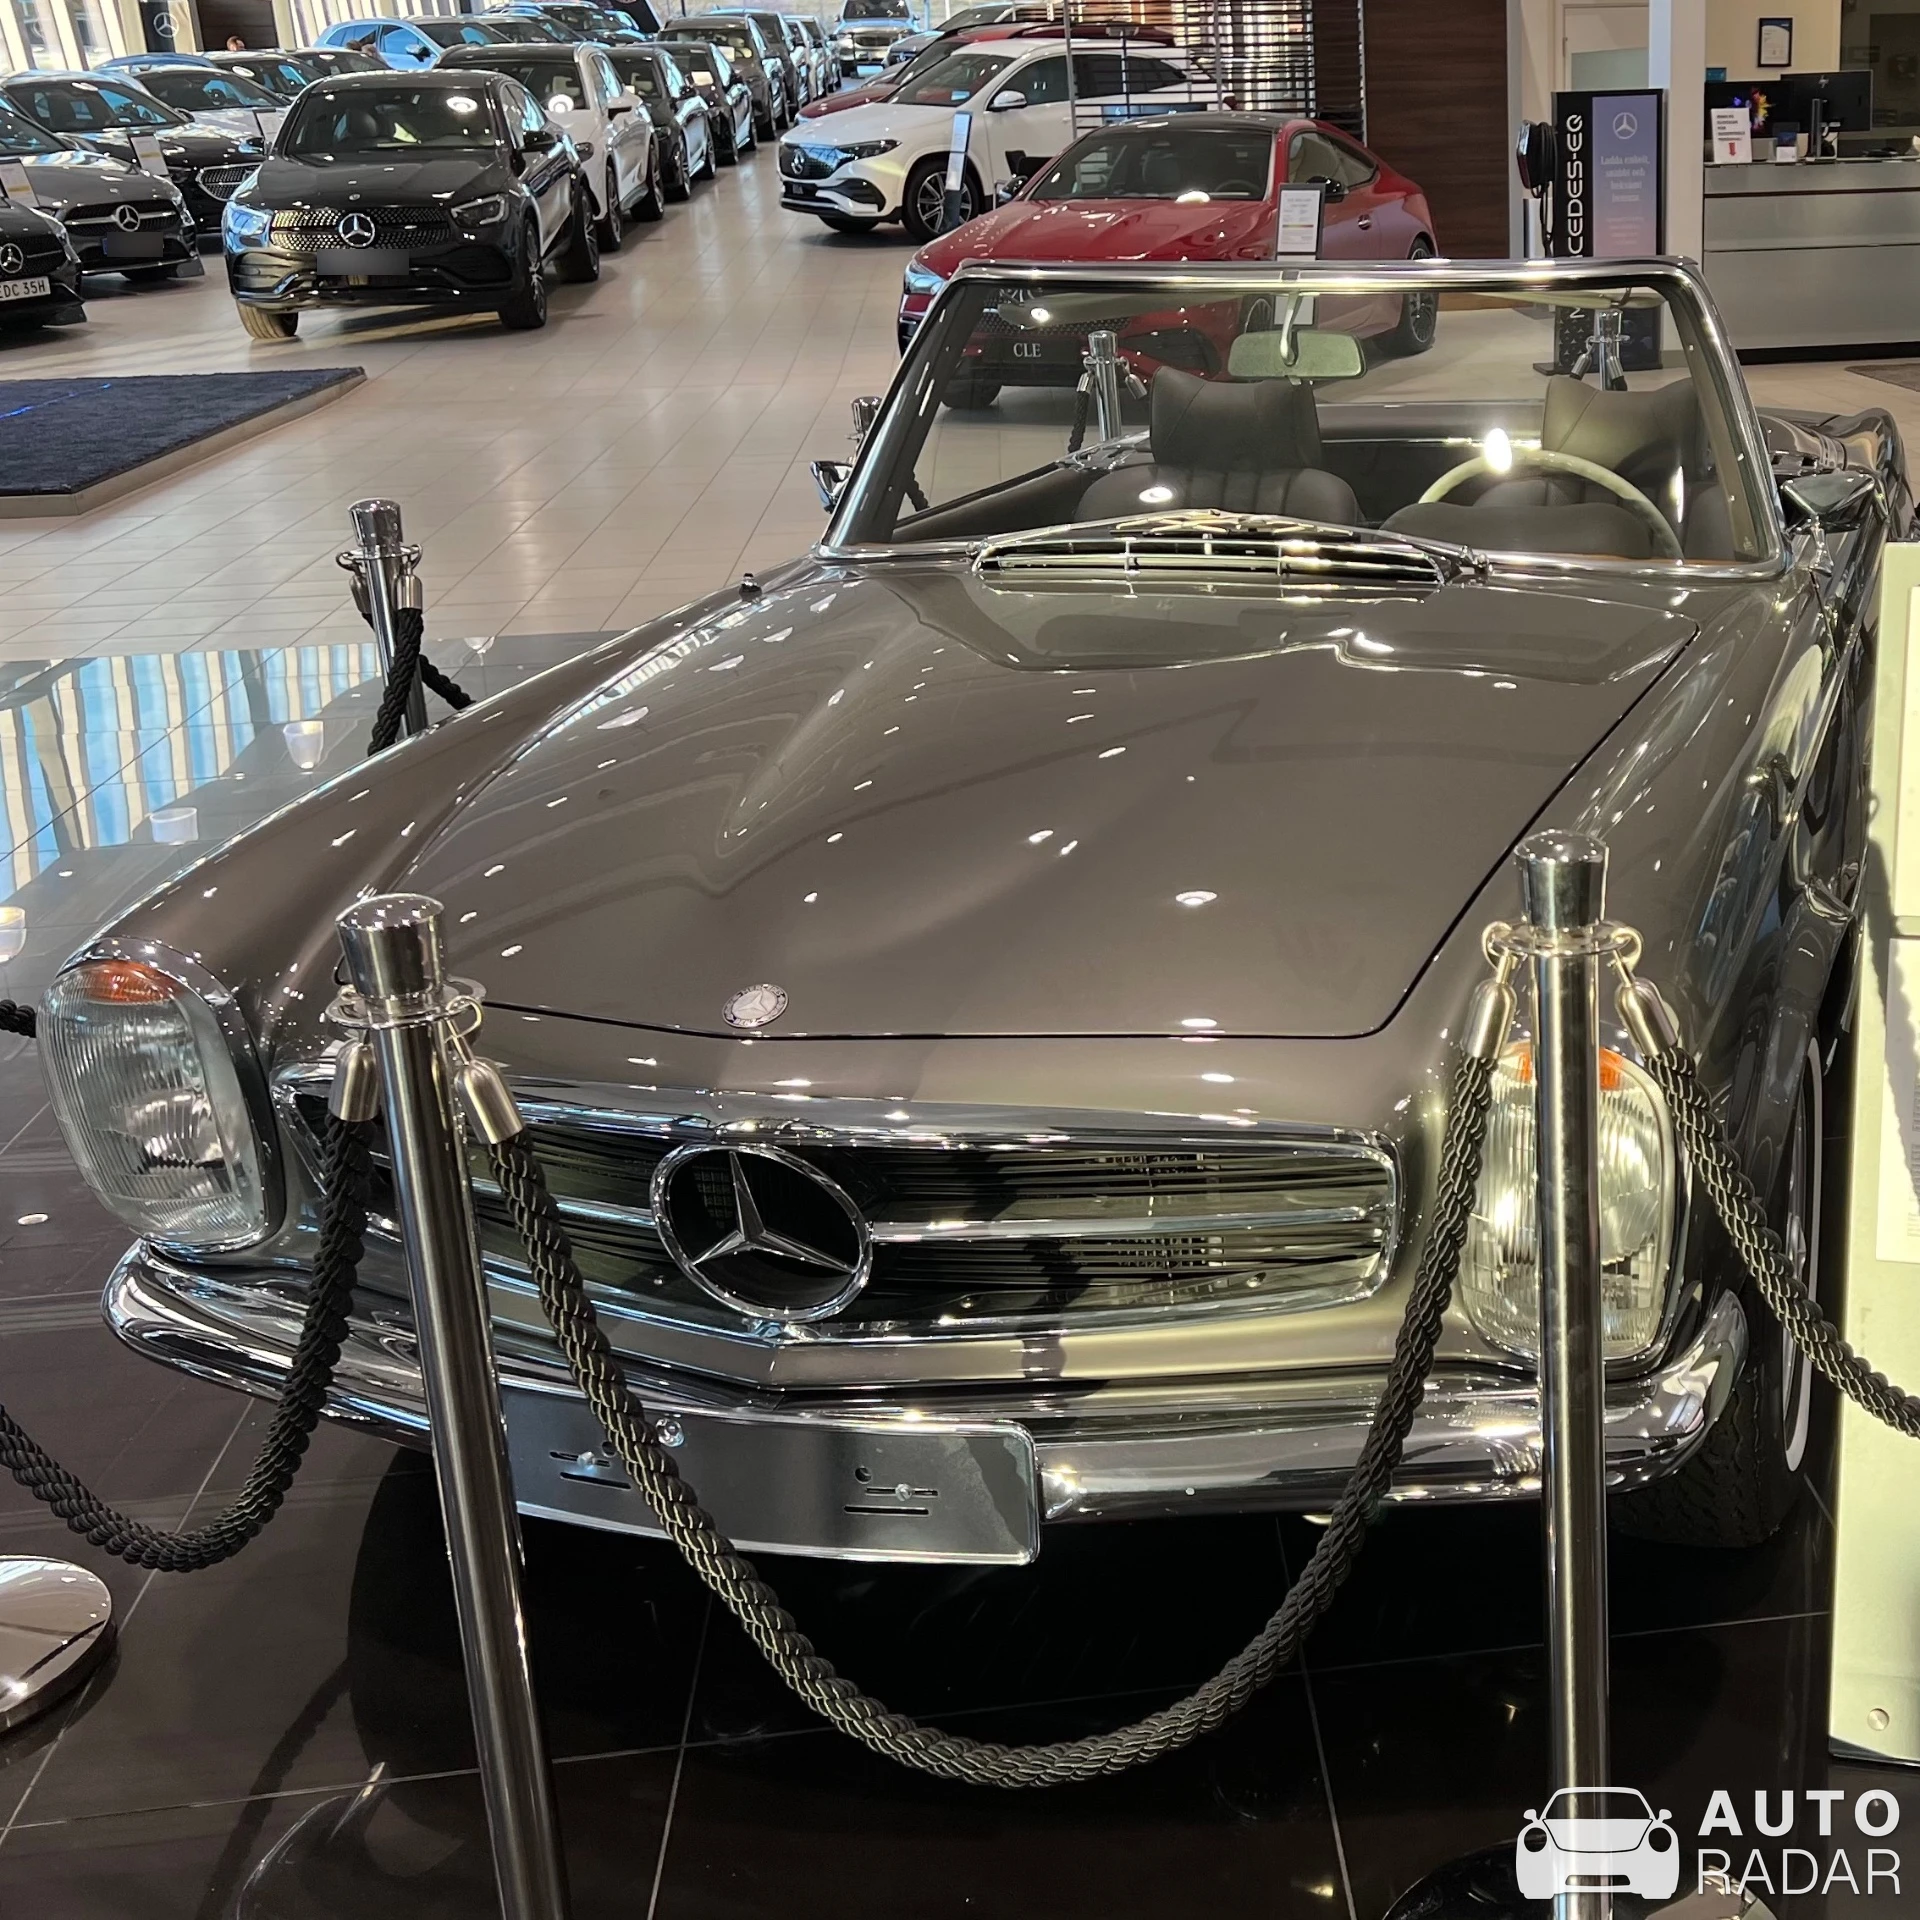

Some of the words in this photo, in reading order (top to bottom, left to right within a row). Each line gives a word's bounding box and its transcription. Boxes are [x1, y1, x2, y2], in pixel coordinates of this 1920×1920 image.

[1566, 114, 1585, 319] MCEDES-EQ
[23, 280, 46, 295] 35H
[1013, 343, 1042, 358] CLE
